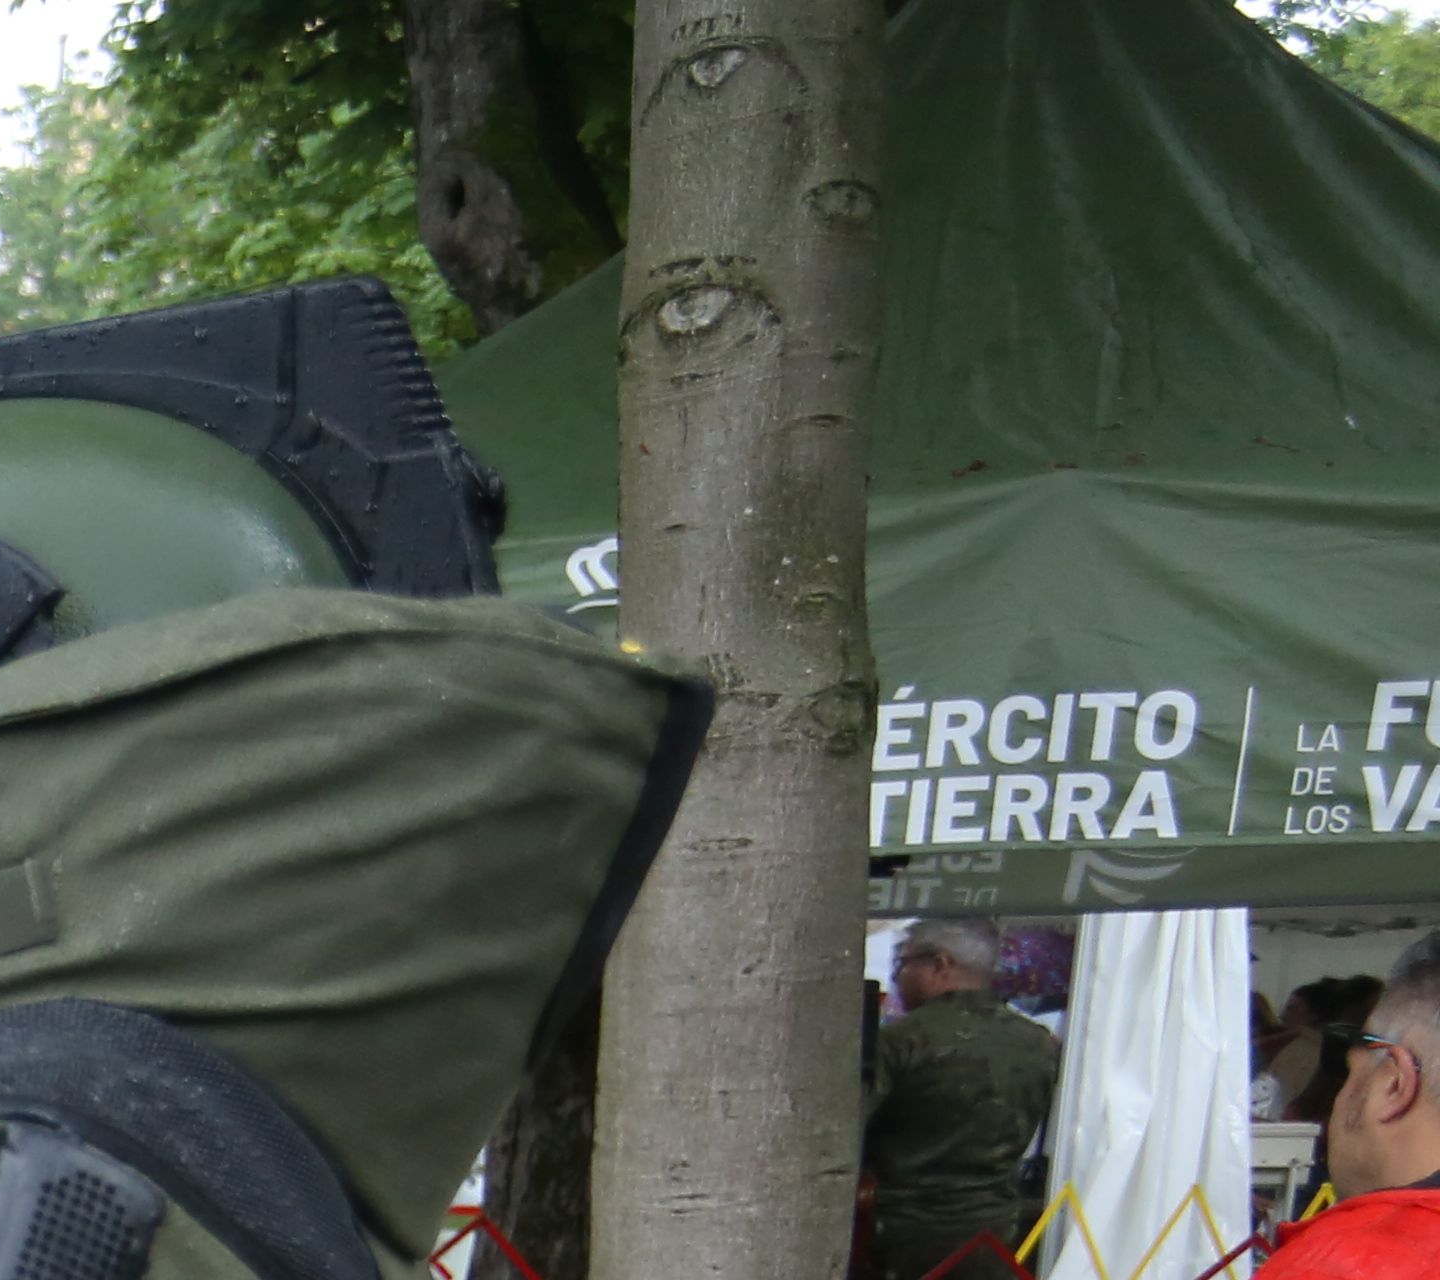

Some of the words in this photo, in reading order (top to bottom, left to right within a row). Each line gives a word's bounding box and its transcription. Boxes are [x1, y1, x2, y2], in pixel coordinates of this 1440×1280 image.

[1296, 723, 1341, 753] LA
[1366, 680, 1440, 752] F
[1290, 766, 1338, 796] DE
[1283, 804, 1352, 835] LOS
